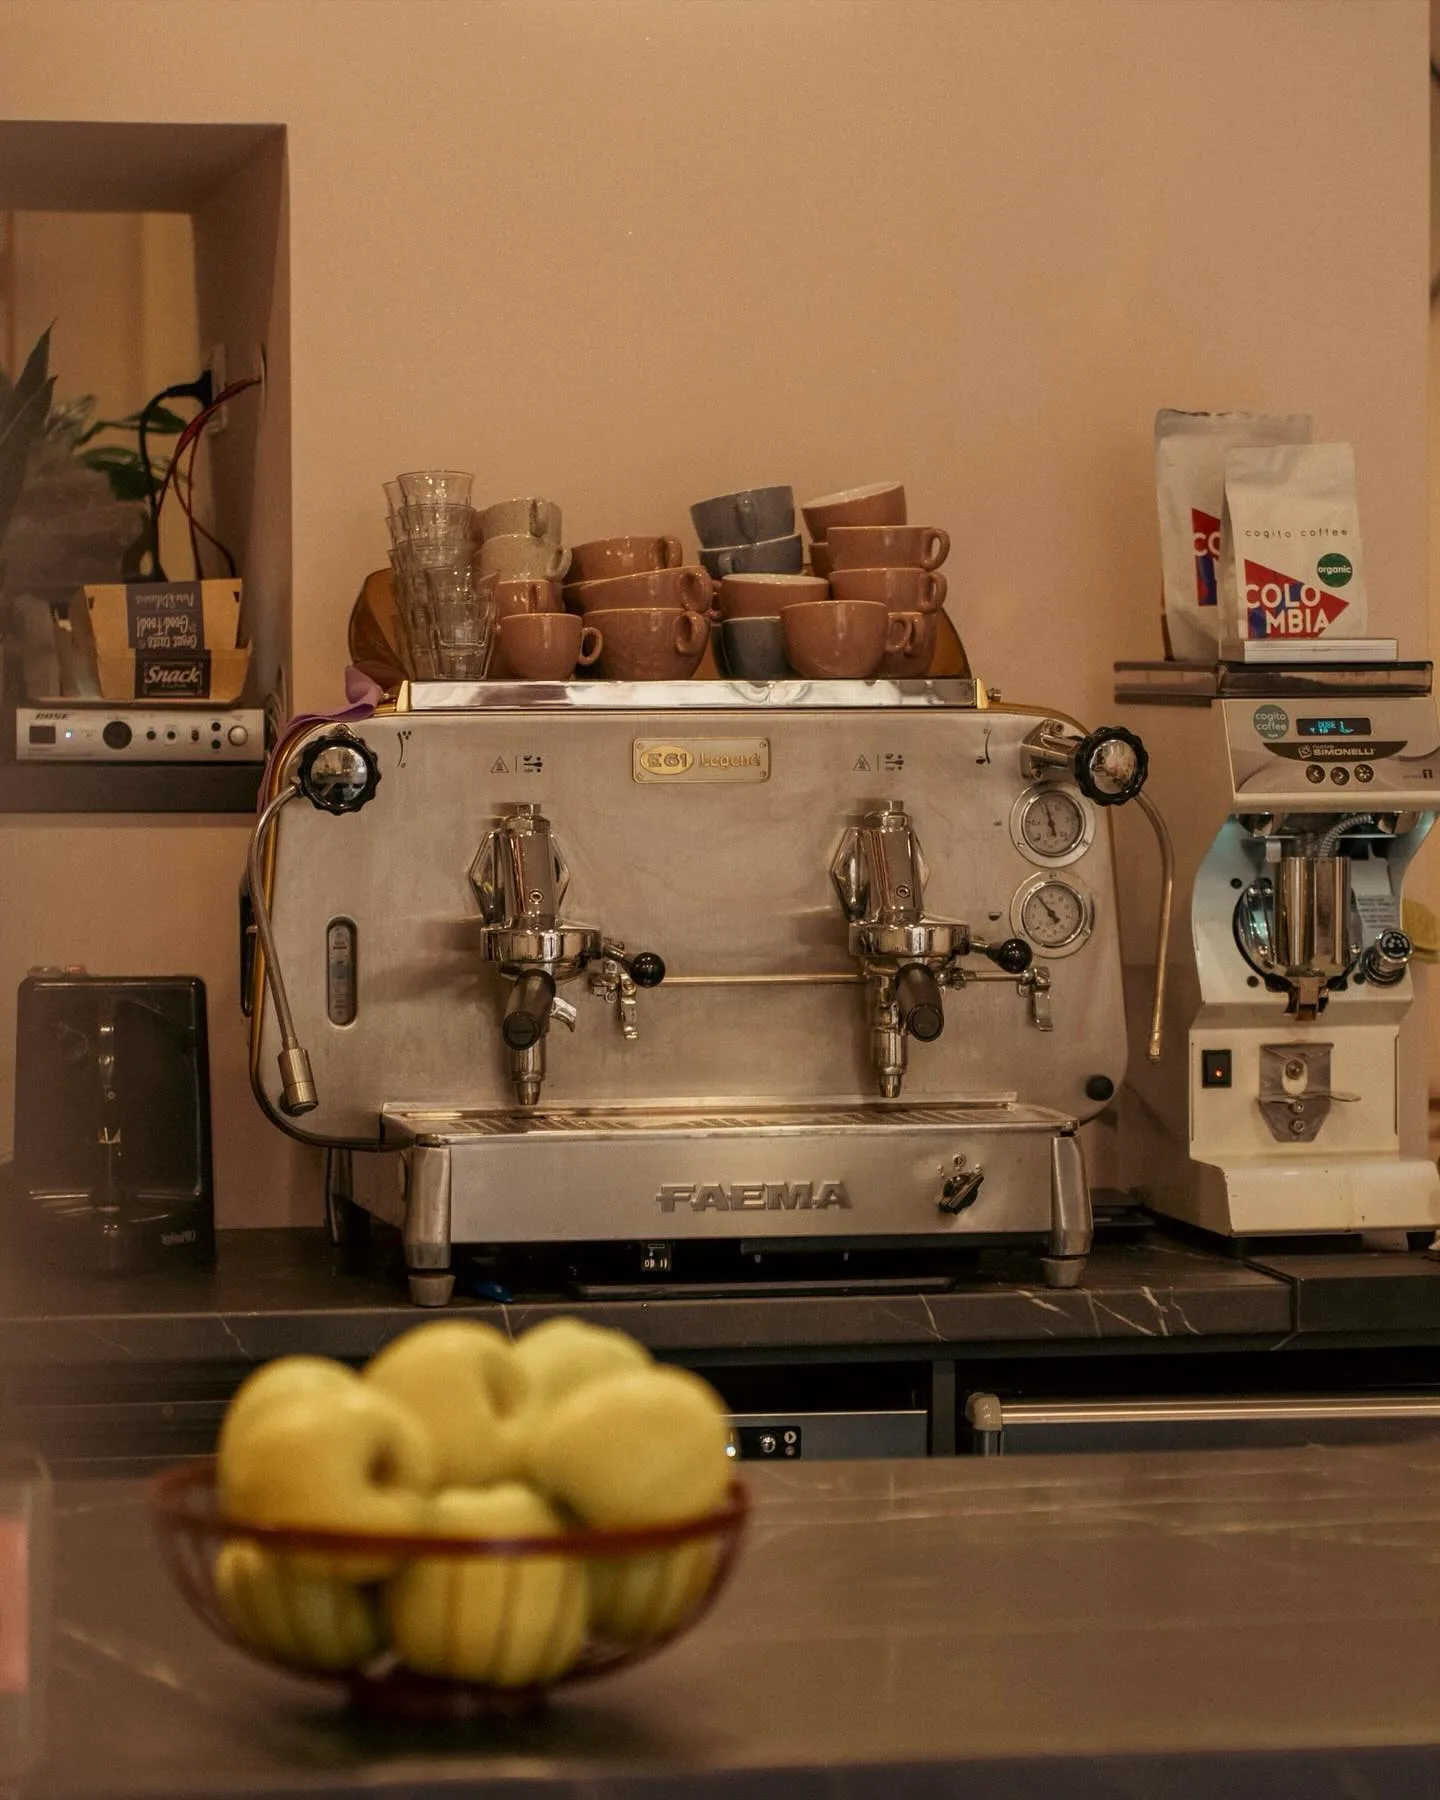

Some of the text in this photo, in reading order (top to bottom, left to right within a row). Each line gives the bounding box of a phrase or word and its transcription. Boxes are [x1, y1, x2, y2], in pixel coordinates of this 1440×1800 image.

[1245, 527, 1348, 540] cogito coffee
[1317, 564, 1352, 576] organic
[1245, 583, 1321, 608] COLO
[1265, 608, 1330, 634] MBIA
[144, 665, 201, 684] Snack
[1255, 711, 1287, 722] cogito
[1256, 719, 1287, 731] coffee
[1312, 748, 1375, 756] SIMONELLI
[656, 1181, 853, 1213] FAEMA
